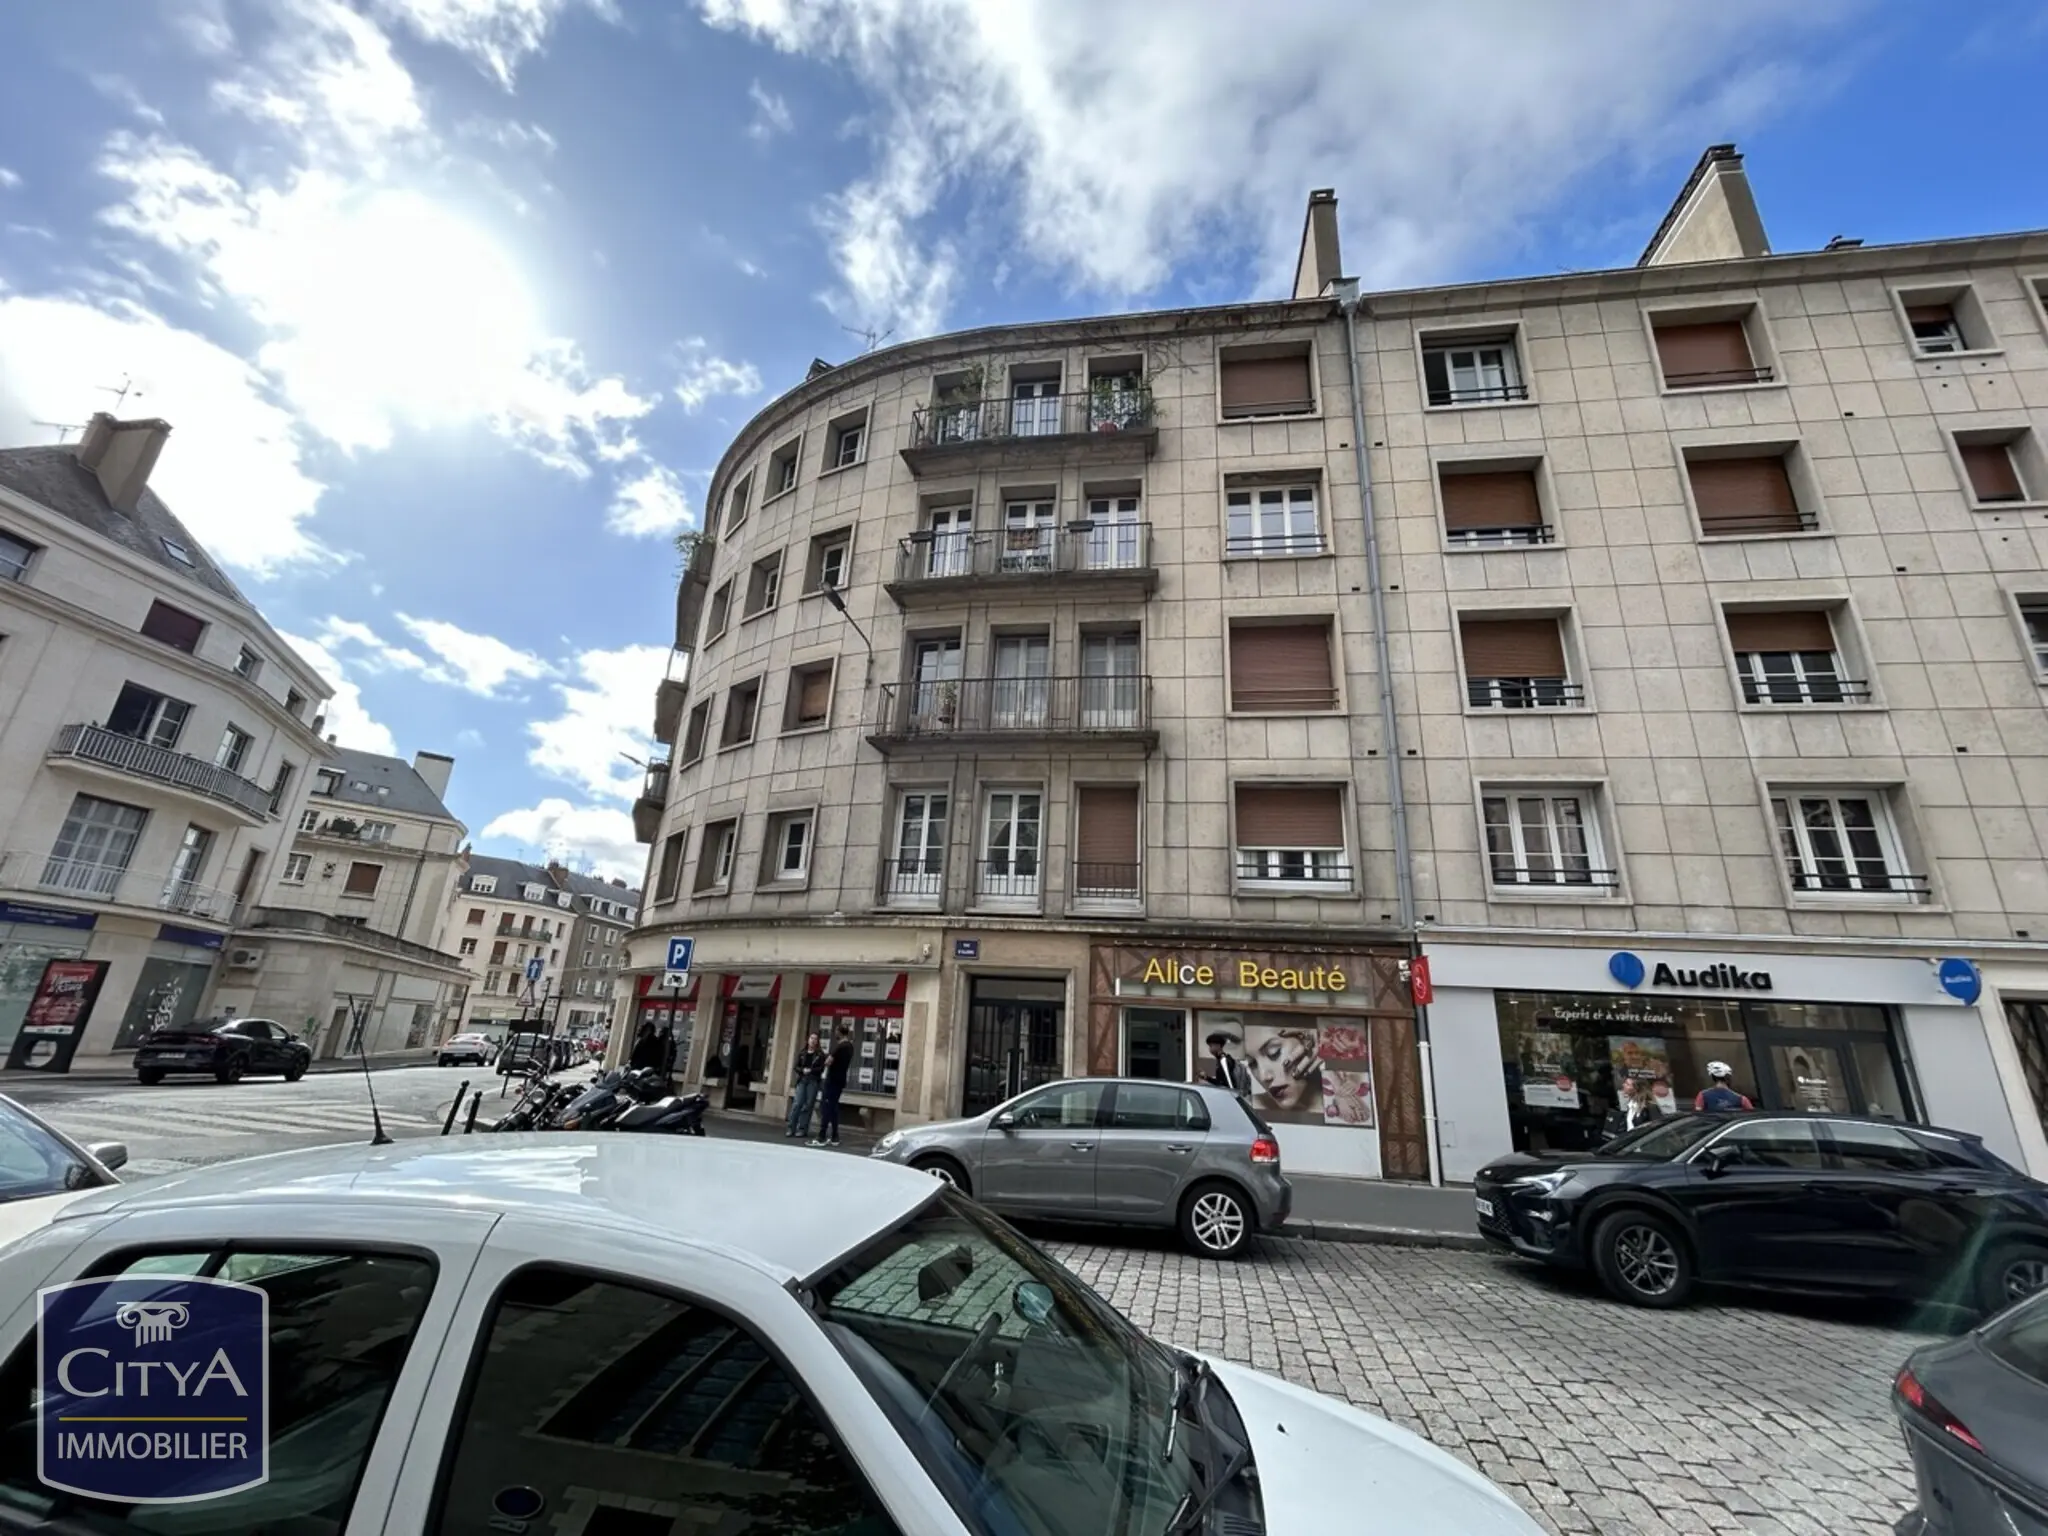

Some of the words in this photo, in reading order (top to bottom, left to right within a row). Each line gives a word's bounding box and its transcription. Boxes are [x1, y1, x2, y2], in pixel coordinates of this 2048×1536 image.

[672, 943, 686, 965] P
[1143, 958, 1215, 986] Alice
[1238, 961, 1347, 992] Beauté
[1652, 962, 1773, 990] Audika
[1552, 1006, 1590, 1022] Experts
[1593, 1008, 1604, 1020] et
[1615, 1010, 1641, 1022] votre
[1643, 1012, 1675, 1024] écoute
